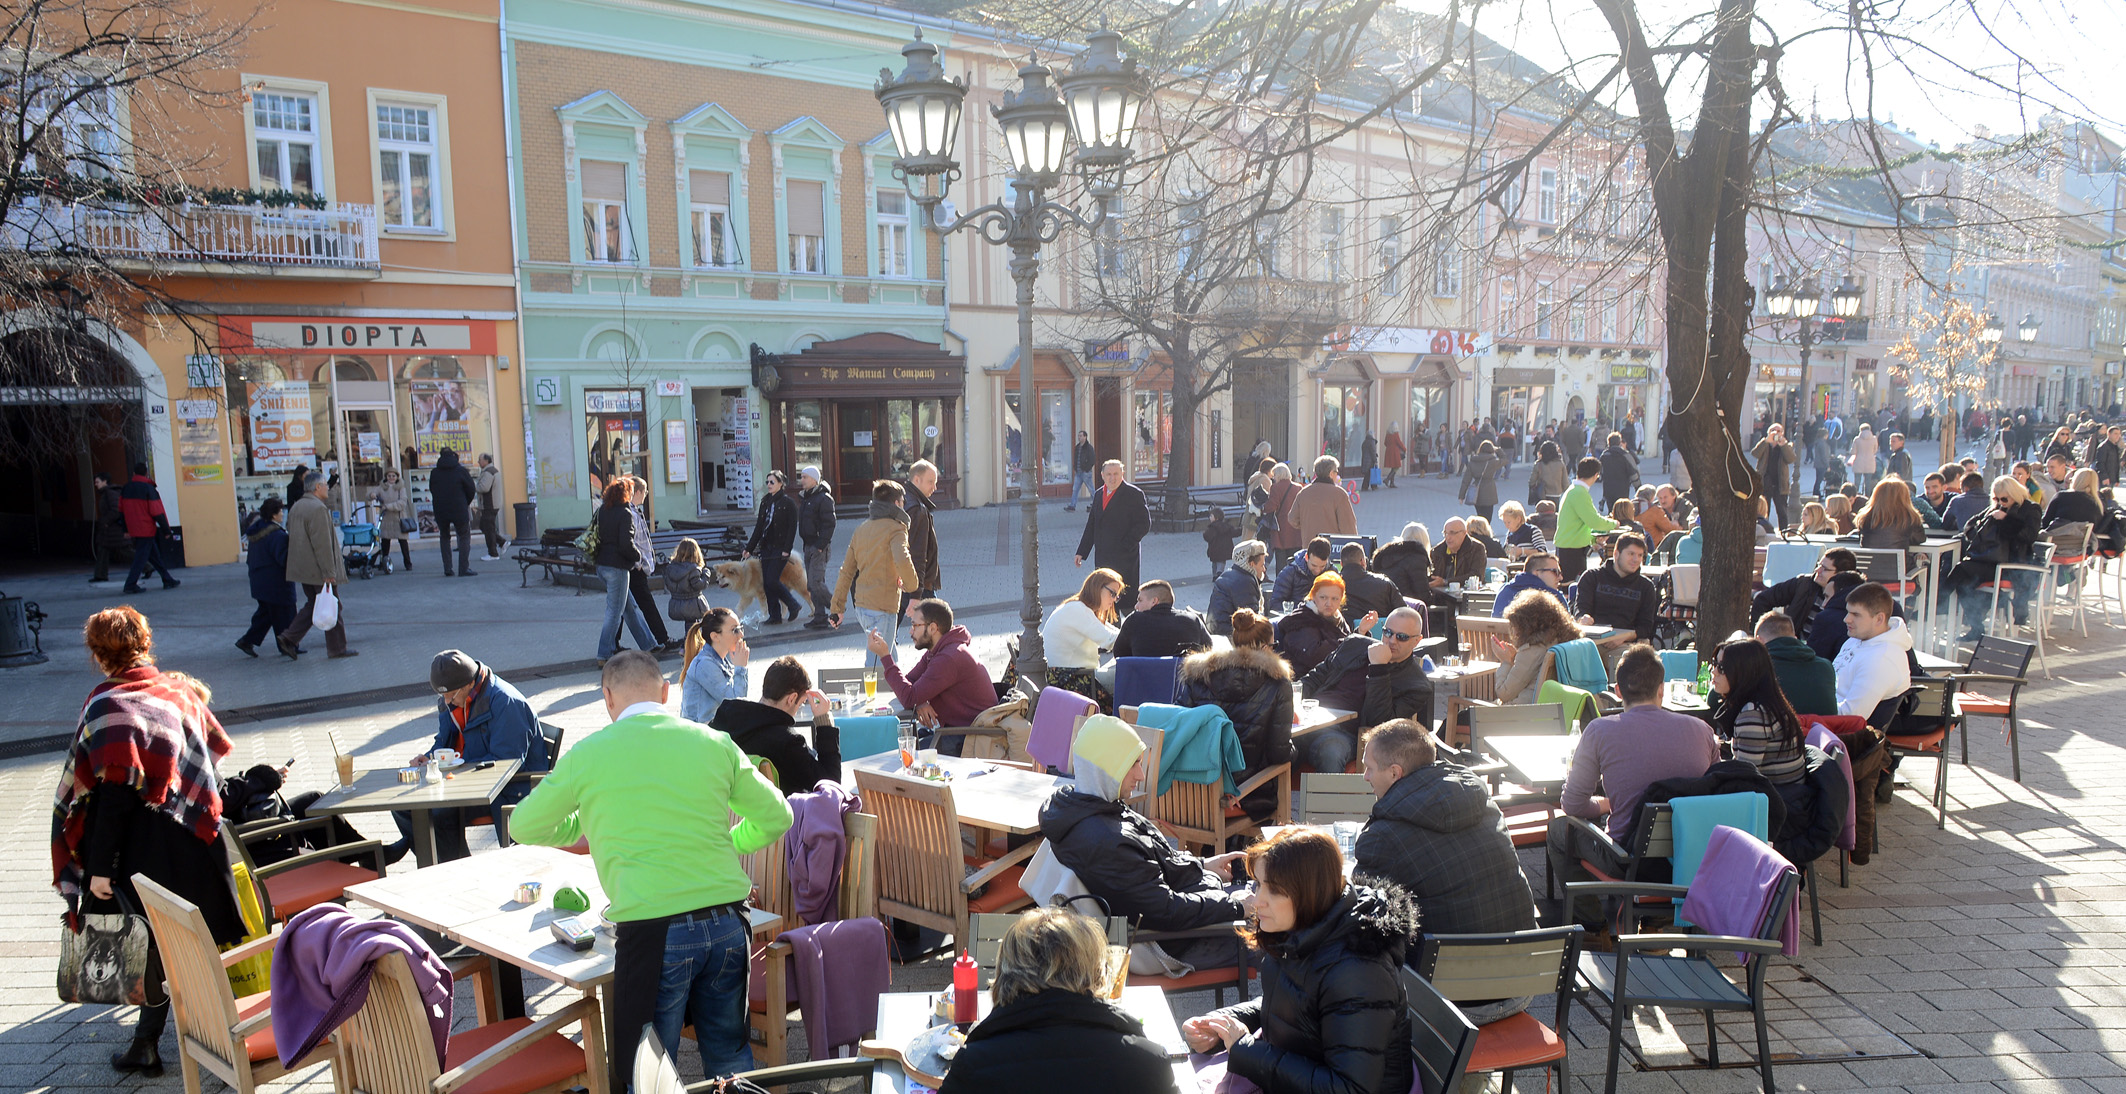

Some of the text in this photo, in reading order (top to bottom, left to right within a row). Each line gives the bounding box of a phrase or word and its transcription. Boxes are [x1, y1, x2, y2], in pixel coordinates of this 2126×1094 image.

[301, 324, 427, 347] DIOPTA
[820, 367, 935, 381] The Manual Company
[255, 419, 312, 444] 50
[420, 439, 471, 453] STUDENT
